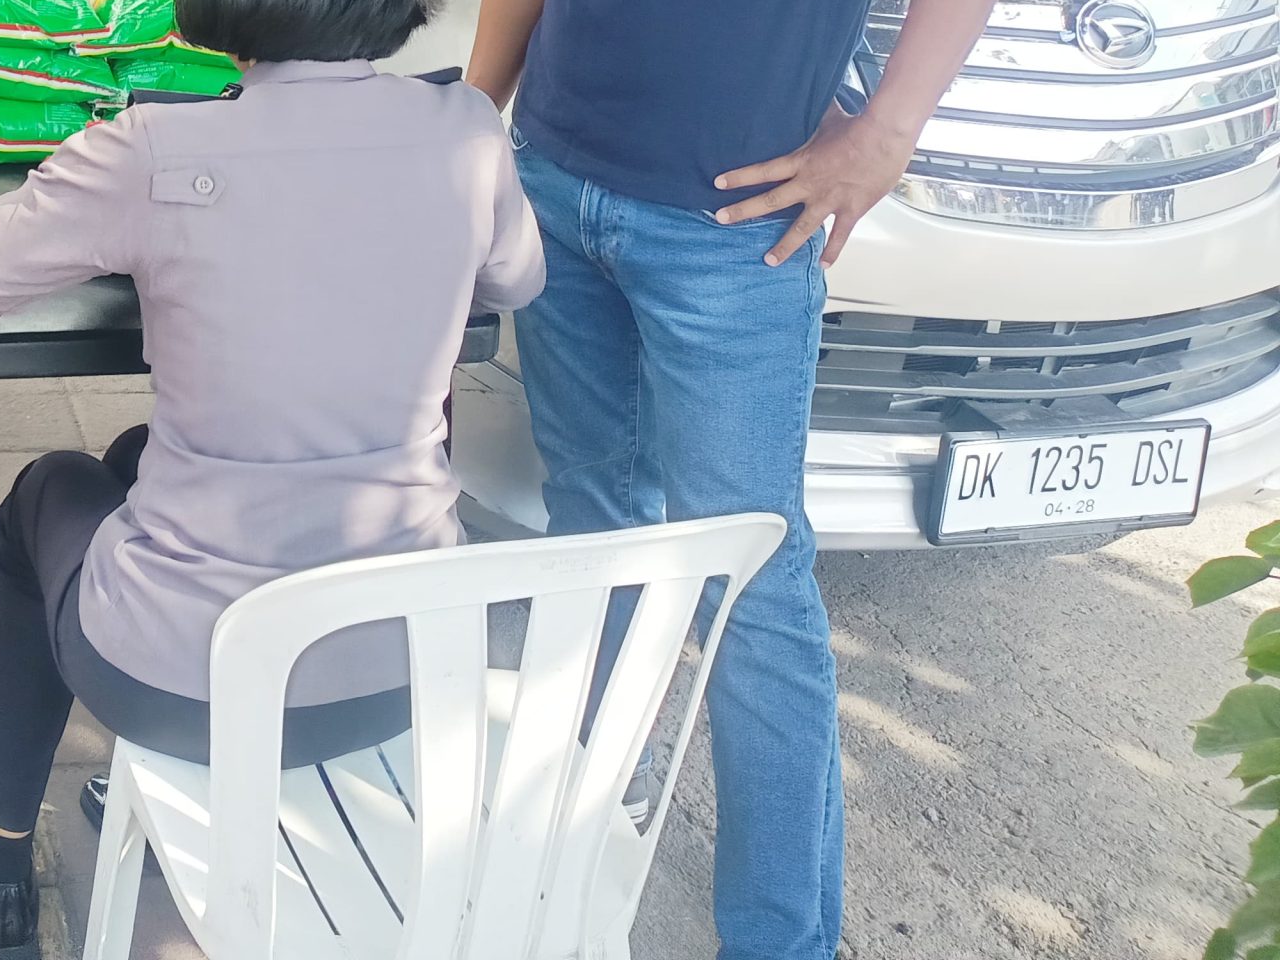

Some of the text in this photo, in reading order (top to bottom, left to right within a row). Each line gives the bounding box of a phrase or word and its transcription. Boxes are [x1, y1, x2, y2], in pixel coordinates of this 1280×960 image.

[958, 438, 1188, 500] DK 1235 DSL
